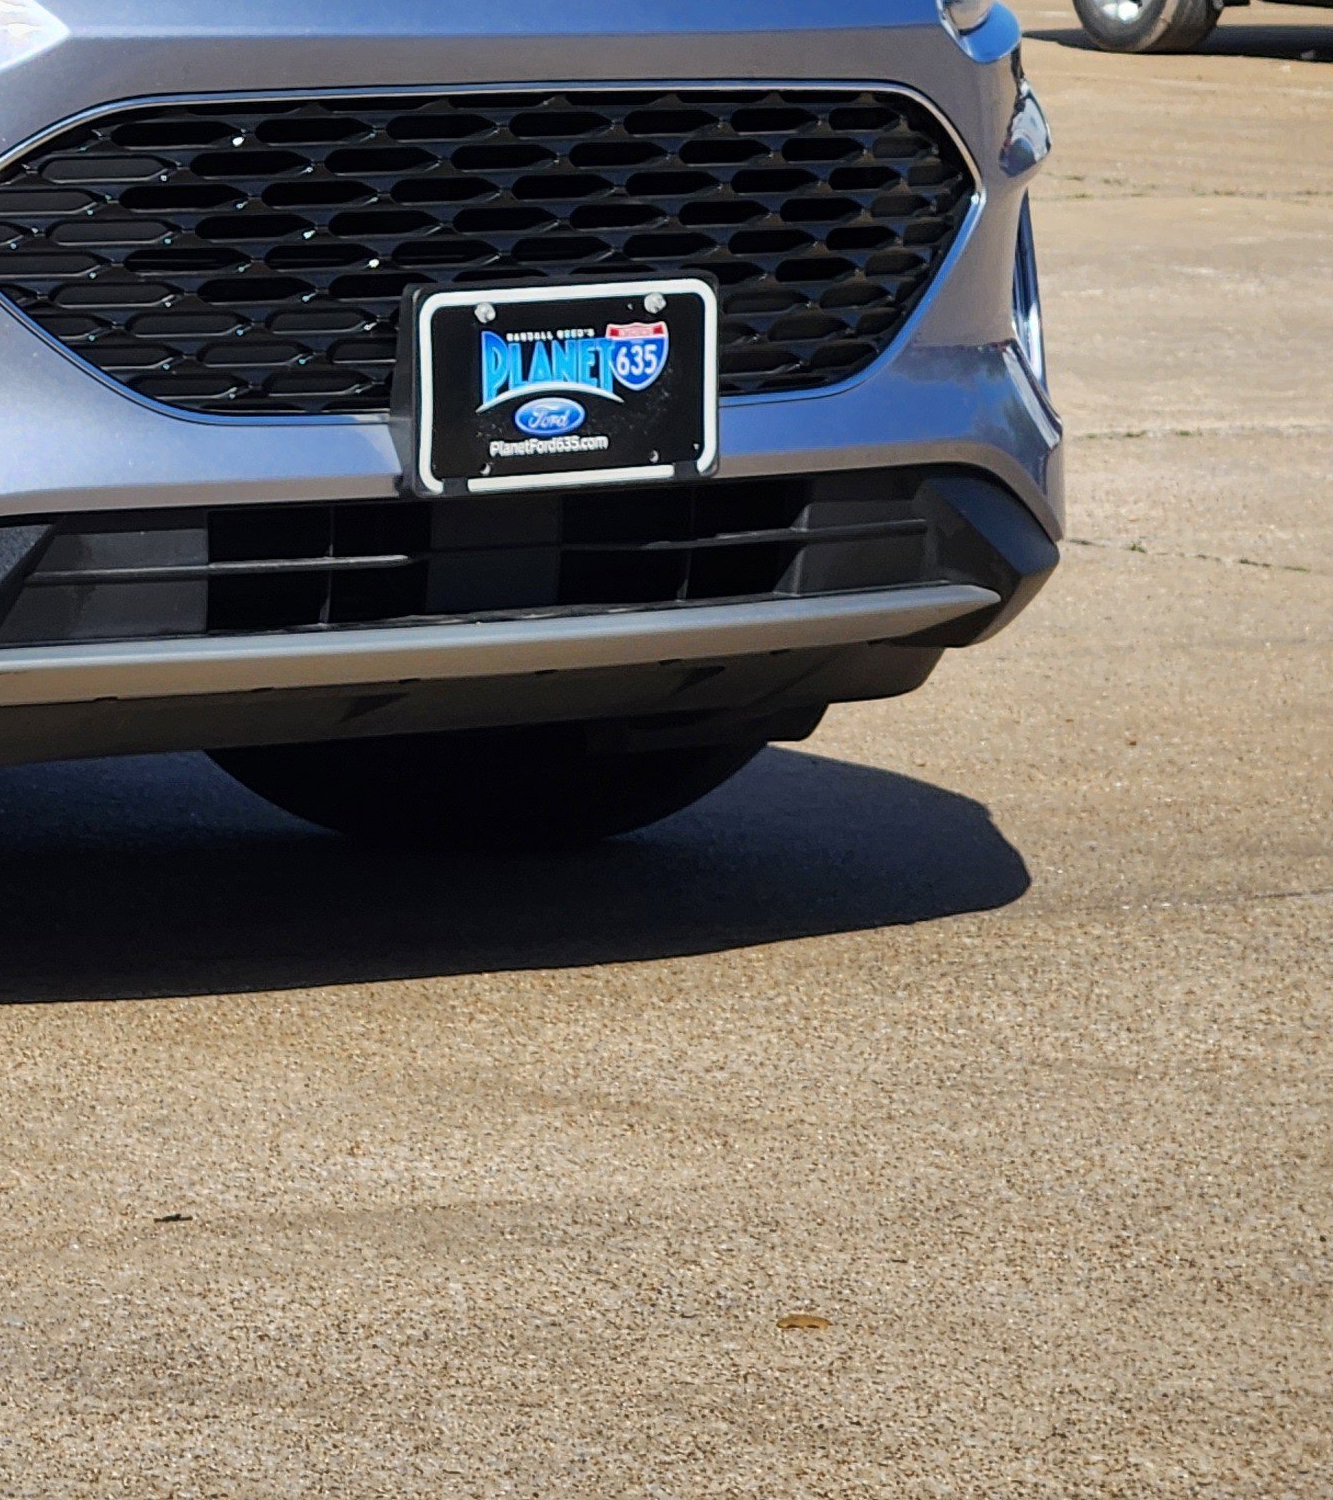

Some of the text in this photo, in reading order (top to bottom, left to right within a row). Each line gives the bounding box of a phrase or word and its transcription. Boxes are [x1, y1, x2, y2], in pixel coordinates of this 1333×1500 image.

[481, 331, 658, 404] PLANET 635
[528, 405, 571, 428] Ford
[489, 435, 609, 457] PlanetFord635.com
